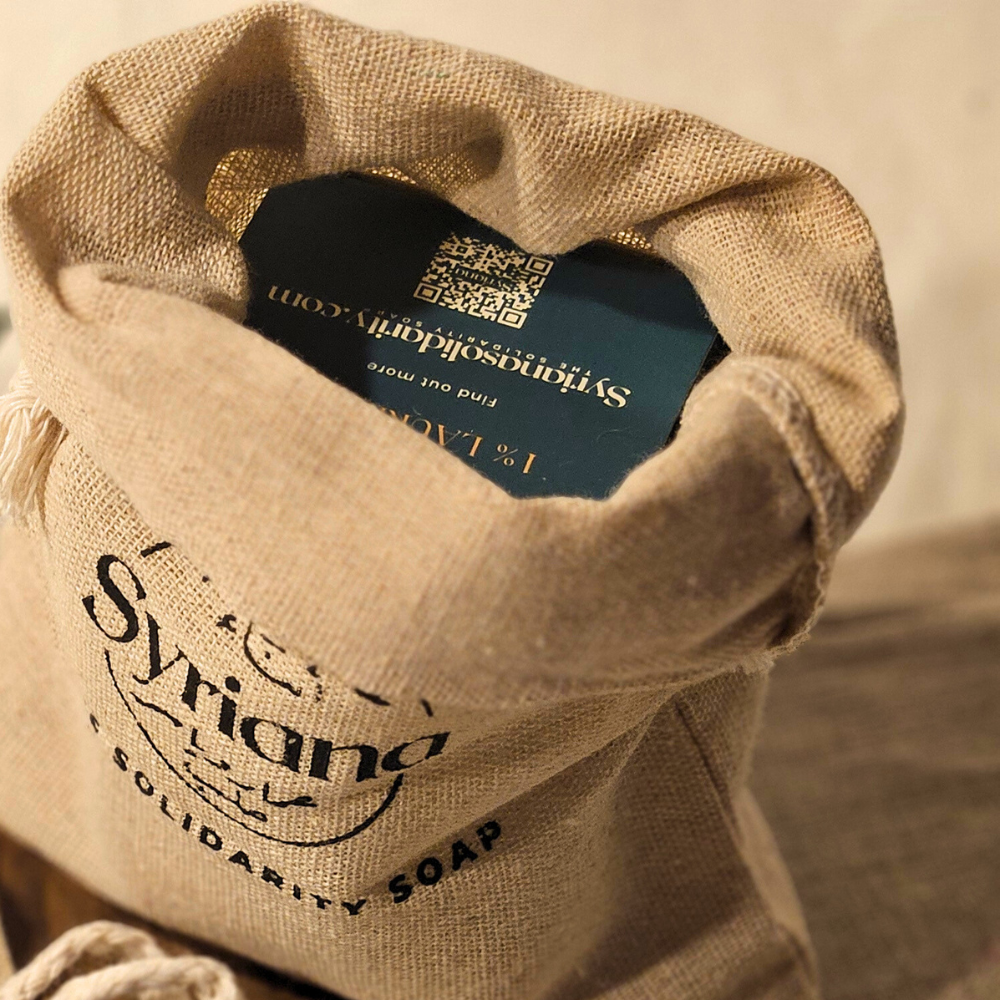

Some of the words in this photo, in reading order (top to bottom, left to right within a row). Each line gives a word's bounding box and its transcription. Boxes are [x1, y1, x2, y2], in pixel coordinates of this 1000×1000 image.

[267, 285, 632, 409] Syrianasolidarity.com
[434, 326, 548, 363] SOLIDARITY
[366, 361, 415, 382] more
[558, 361, 592, 378] THE
[420, 376, 452, 393] out
[456, 388, 498, 408] Find
[82, 554, 451, 782] Syriana
[113, 747, 367, 915] SOLIDARITY
[388, 819, 502, 904] SOAP
